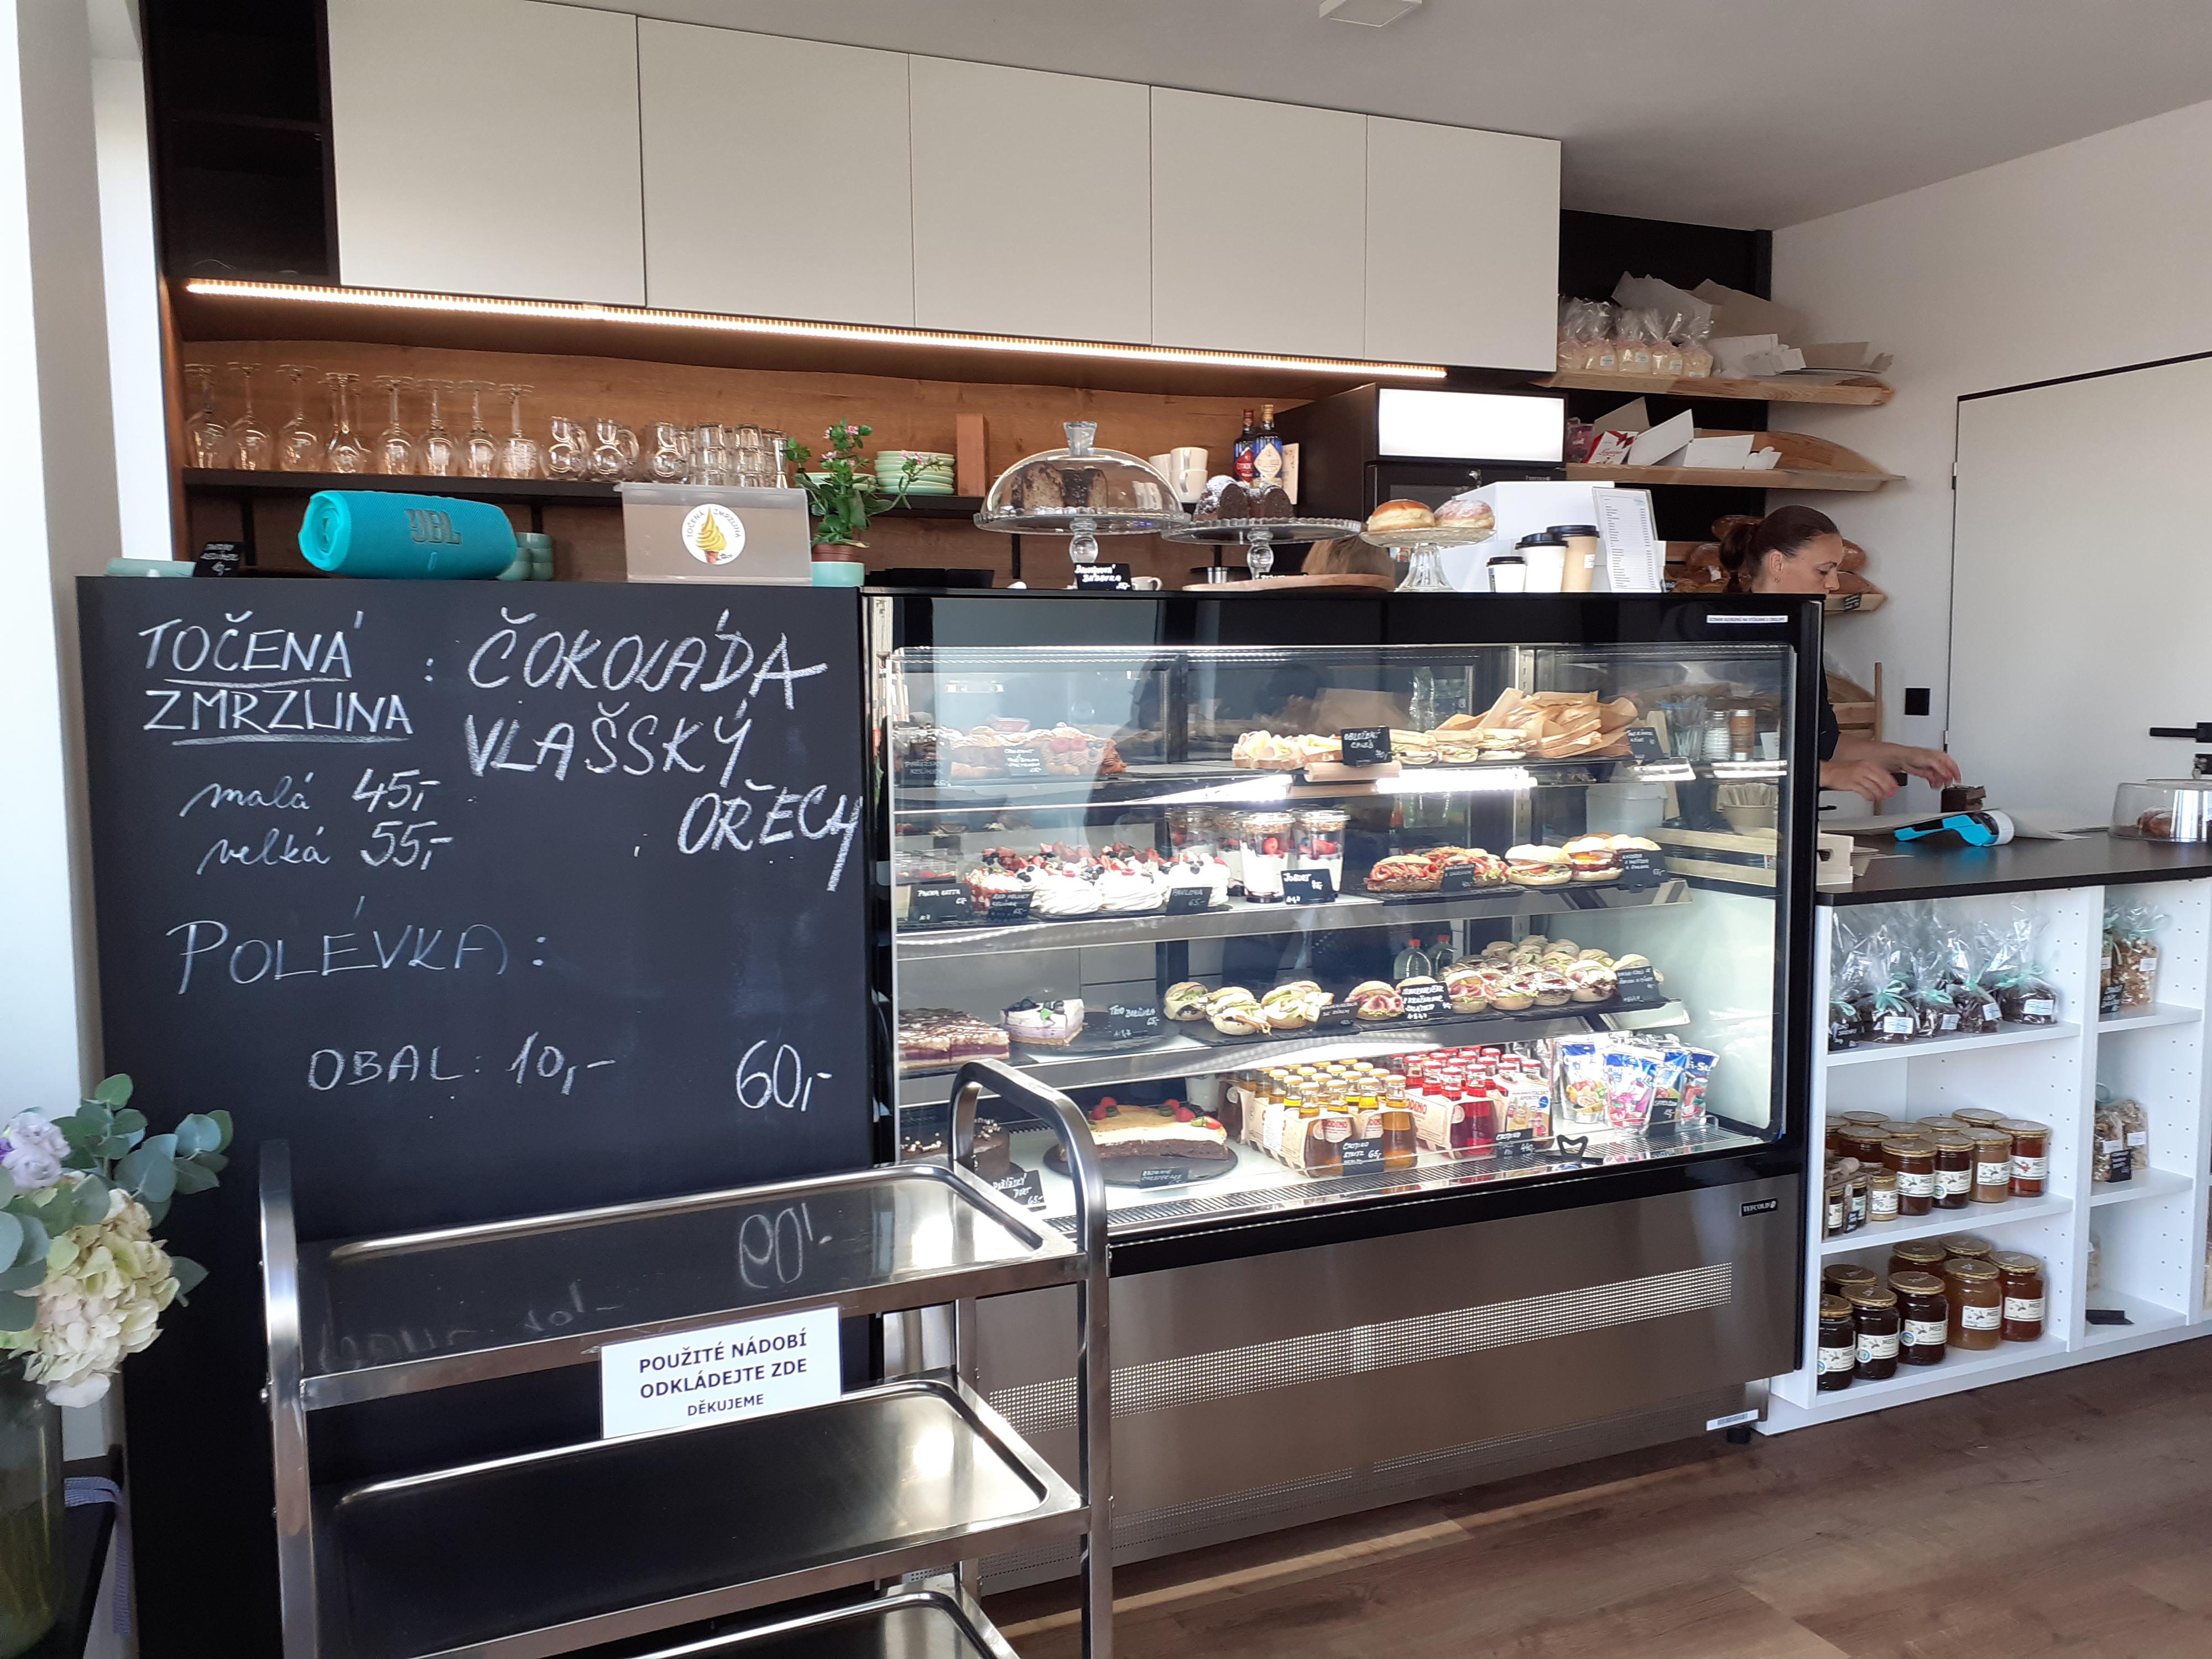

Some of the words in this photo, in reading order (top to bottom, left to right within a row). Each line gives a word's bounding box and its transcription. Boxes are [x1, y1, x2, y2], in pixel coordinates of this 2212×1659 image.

[404, 508, 463, 545] JBL
[138, 610, 363, 679] TOČENÁ
[467, 607, 828, 711] ČOKOLÁDA
[143, 689, 414, 734] ZMRZLINA
[464, 698, 752, 788] VLAŠSKÝ
[179, 771, 314, 817] malá
[196, 826, 331, 875] velká
[639, 1341, 725, 1373] POUŽITÉ
[732, 1328, 807, 1358] NÁDOBÍ
[640, 1365, 765, 1399] ODKLÁDEJTE
[771, 1358, 807, 1378] ZDE
[687, 1394, 764, 1416] DĚKUJEME
